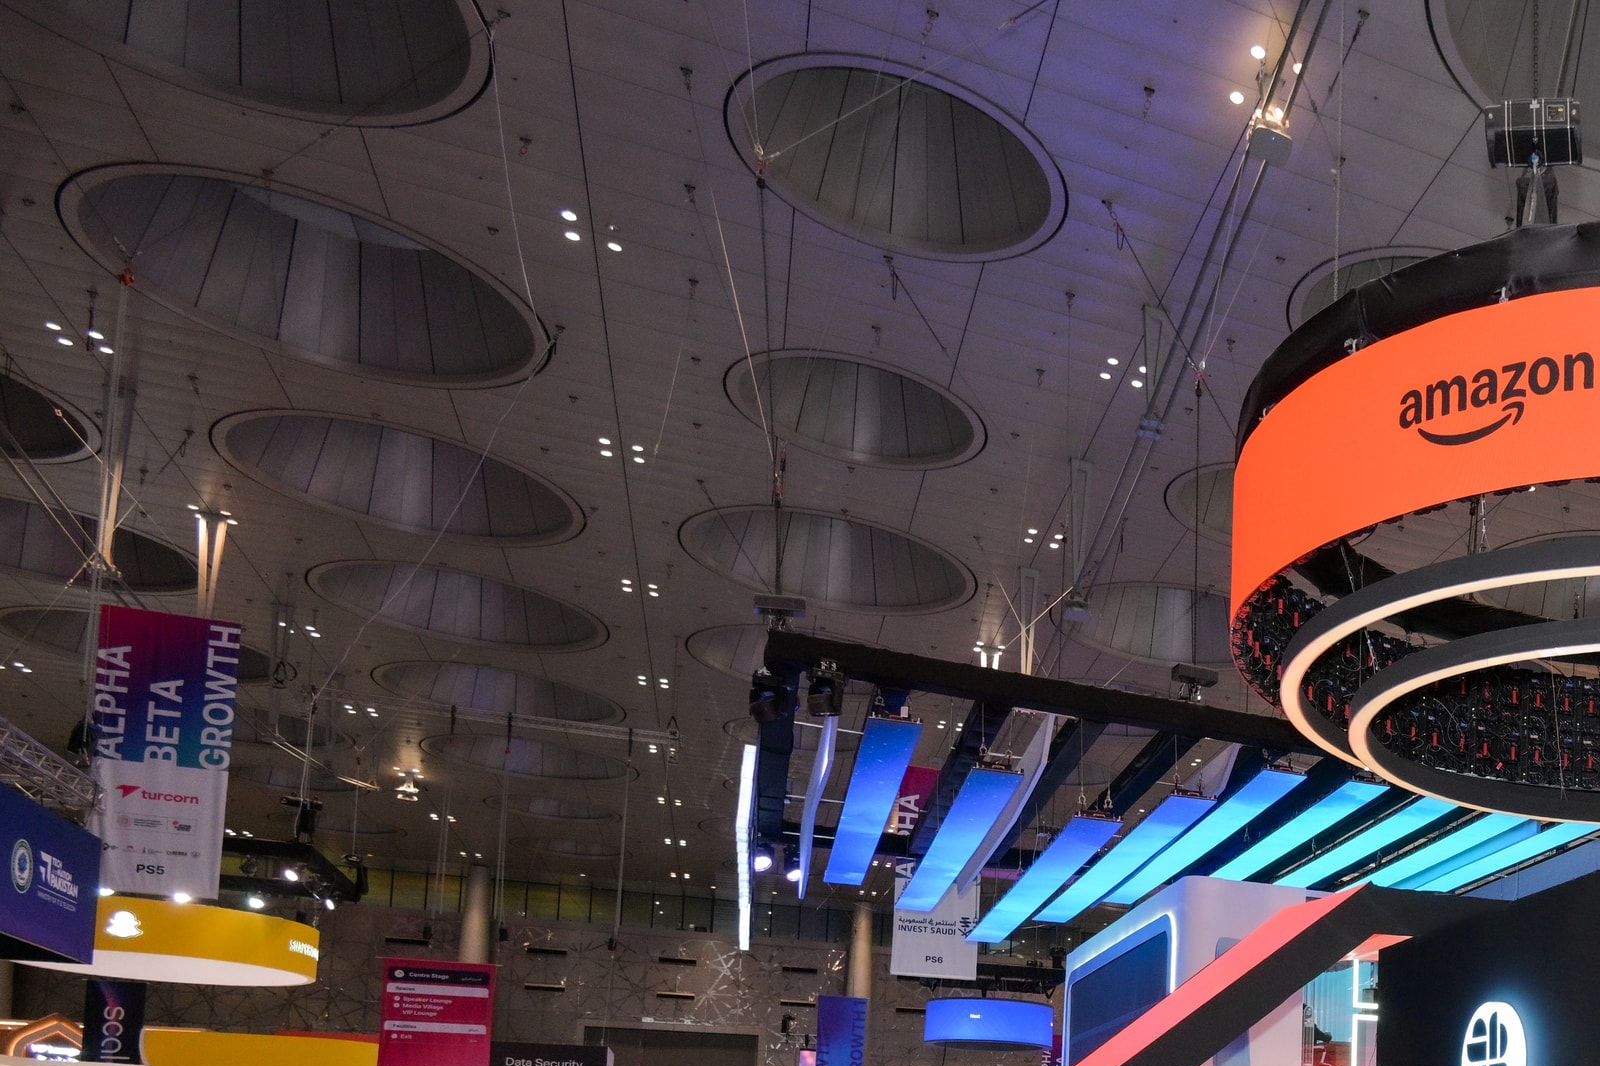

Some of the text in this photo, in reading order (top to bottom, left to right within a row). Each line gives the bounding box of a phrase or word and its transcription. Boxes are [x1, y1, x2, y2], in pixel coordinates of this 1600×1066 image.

[1399, 351, 1595, 429] amazon
[94, 645, 133, 761] ALPHA
[198, 624, 242, 772] GROWTH
[143, 679, 185, 769] BETA
[141, 790, 199, 804] turcorn
[136, 864, 165, 875] PS5
[898, 924, 956, 935] INVEST SAUDI
[925, 955, 943, 963] PS6
[402, 996, 428, 1004] Speaker
[505, 1057, 533, 1066] Data
